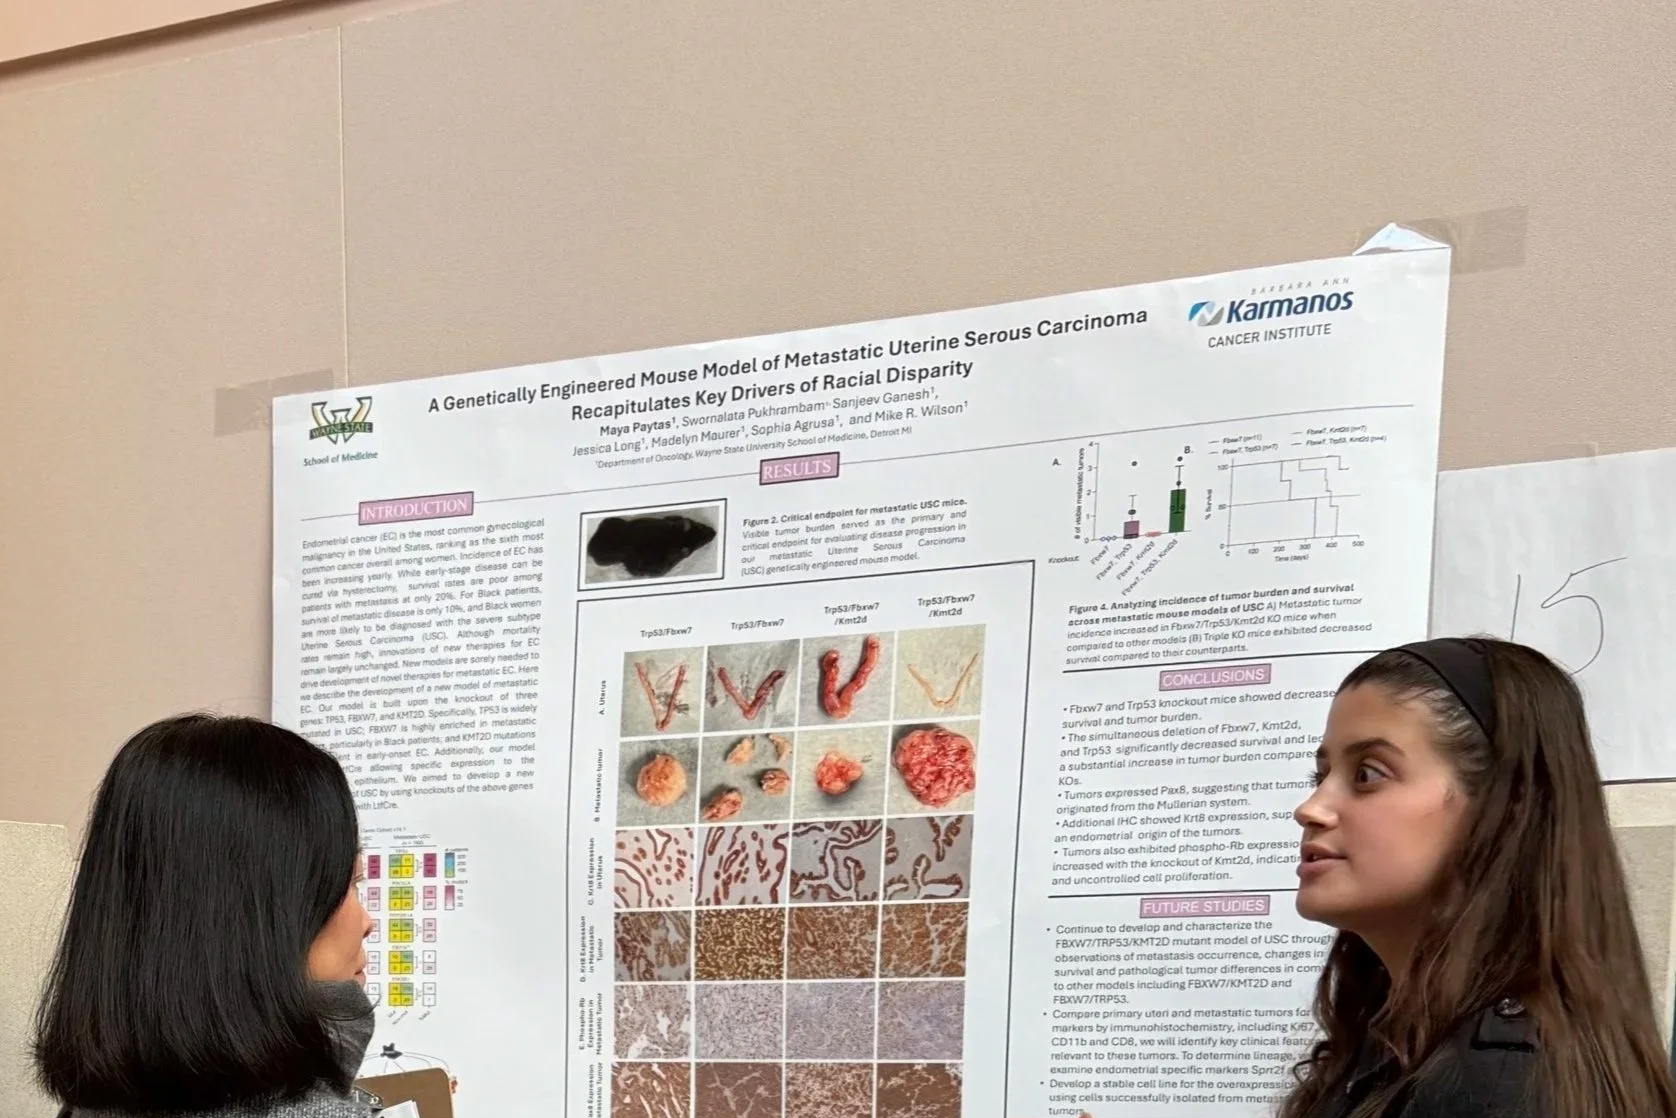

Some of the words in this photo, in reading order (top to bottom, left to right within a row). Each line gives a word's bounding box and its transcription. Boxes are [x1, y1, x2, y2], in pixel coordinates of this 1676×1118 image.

[1226, 290, 1354, 323] Karmanos
[1208, 331, 1260, 348] CANCER
[1264, 323, 1332, 342] INSTITUTE
[428, 398, 439, 412] A
[443, 387, 536, 410] Genetically
[540, 373, 635, 399] Engineered
[640, 369, 698, 386] Mouse
[702, 357, 756, 378] Model
[761, 354, 780, 371] of
[784, 343, 883, 367] Metastatic
[888, 336, 959, 355] Uterine
[964, 326, 1031, 346] Serous
[1036, 310, 1147, 336] Carcinoma
[571, 396, 690, 419] Recapitulates
[695, 390, 726, 406] Key
[731, 383, 795, 401] Drivers
[799, 376, 818, 392] of
[822, 369, 881, 389] Racial
[886, 360, 973, 383] Disparity
[599, 425, 630, 436] Maya
[681, 411, 745, 426] Swornalata
[832, 396, 880, 408] Sanjeev
[572, 444, 612, 456] Jessica
[651, 434, 698, 447] Madelyn
[750, 422, 791, 435] Sophia
[848, 412, 872, 424] and
[874, 410, 903, 421] Mike
[905, 407, 917, 418] R.
[645, 455, 654, 463] of
[694, 448, 722, 457] Wayne
[723, 445, 745, 454] State
[745, 441, 786, 451] University
[786, 436, 816, 447] School
[816, 435, 826, 443] of
[869, 428, 900, 438] Detroit
[900, 426, 912, 434] MI
[303, 455, 329, 466] School
[330, 454, 340, 463] of
[341, 451, 378, 461] Medicine
[763, 459, 831, 480] RESULTS
[362, 498, 467, 520] INTRODUCTION
[742, 518, 769, 527] Figure
[770, 515, 778, 524] 2.
[780, 512, 812, 522] Critical
[813, 509, 853, 519] endpoint
[854, 507, 868, 515] for
[869, 502, 918, 513] metastatic
[919, 499, 940, 509] USC
[941, 498, 967, 506] mice.
[486, 518, 544, 533] gynecological
[824, 602, 879, 614] Trp53/Fbxw7
[918, 594, 975, 607] Trp53/Fbxw7
[1068, 605, 1098, 614] Figure
[1110, 599, 1157, 609] Analyzing
[1158, 596, 1207, 605] incidence
[1208, 593, 1219, 601] of
[1220, 592, 1252, 600] tumor
[1252, 588, 1289, 601] burden
[1290, 585, 1311, 595] and
[1312, 583, 1354, 593] survival
[834, 616, 867, 626] /Kmt2d
[928, 608, 962, 618] /Kmt2d
[1510, 556, 1628, 676] 15
[640, 627, 693, 638] Trp53/Fbxw7
[731, 618, 784, 630] Trp53/Fbxw7
[1162, 668, 1264, 687] CONCLUSIONS
[1069, 702, 1103, 713] Fbxw7
[1104, 701, 1125, 711] and
[1126, 699, 1156, 711] Trp53
[1158, 697, 1208, 707] knockout
[1209, 695, 1236, 704] mice
[1238, 691, 1282, 702] showed
[1283, 690, 1334, 702] decrease
[1061, 717, 1102, 728] survival
[1103, 716, 1124, 726] and
[1126, 715, 1158, 724] tumor
[1160, 712, 1202, 722] burden.
[1068, 733, 1086, 742] The
[1088, 730, 1160, 741] simultaneous
[1161, 727, 1206, 736] deletion
[1207, 724, 1219, 734] of
[1220, 722, 1259, 733] Fbxw7,
[1261, 720, 1301, 730] Kmt2d,
[1056, 803, 1108, 815] originated
[1110, 802, 1135, 811] from
[1137, 802, 1155, 810] the
[1156, 799, 1207, 809] Mullerian
[1209, 798, 1250, 809] system.
[1144, 901, 1199, 914] FUTURE
[1203, 899, 1265, 912] STUDIES
[1055, 924, 1104, 934] Continue
[1118, 923, 1160, 932] develop
[1162, 922, 1183, 931] and
[1184, 922, 1252, 930] characterize
[1254, 920, 1272, 929] the
[1053, 982, 1064, 990] to
[1066, 981, 1094, 990] other
[1095, 980, 1135, 989] models
[1136, 980, 1186, 990] including
[1187, 978, 1269, 988] FBXW7/KMT2D
[1270, 978, 1292, 987] and
[1052, 994, 1129, 1004] FBXW7/TRP53.
